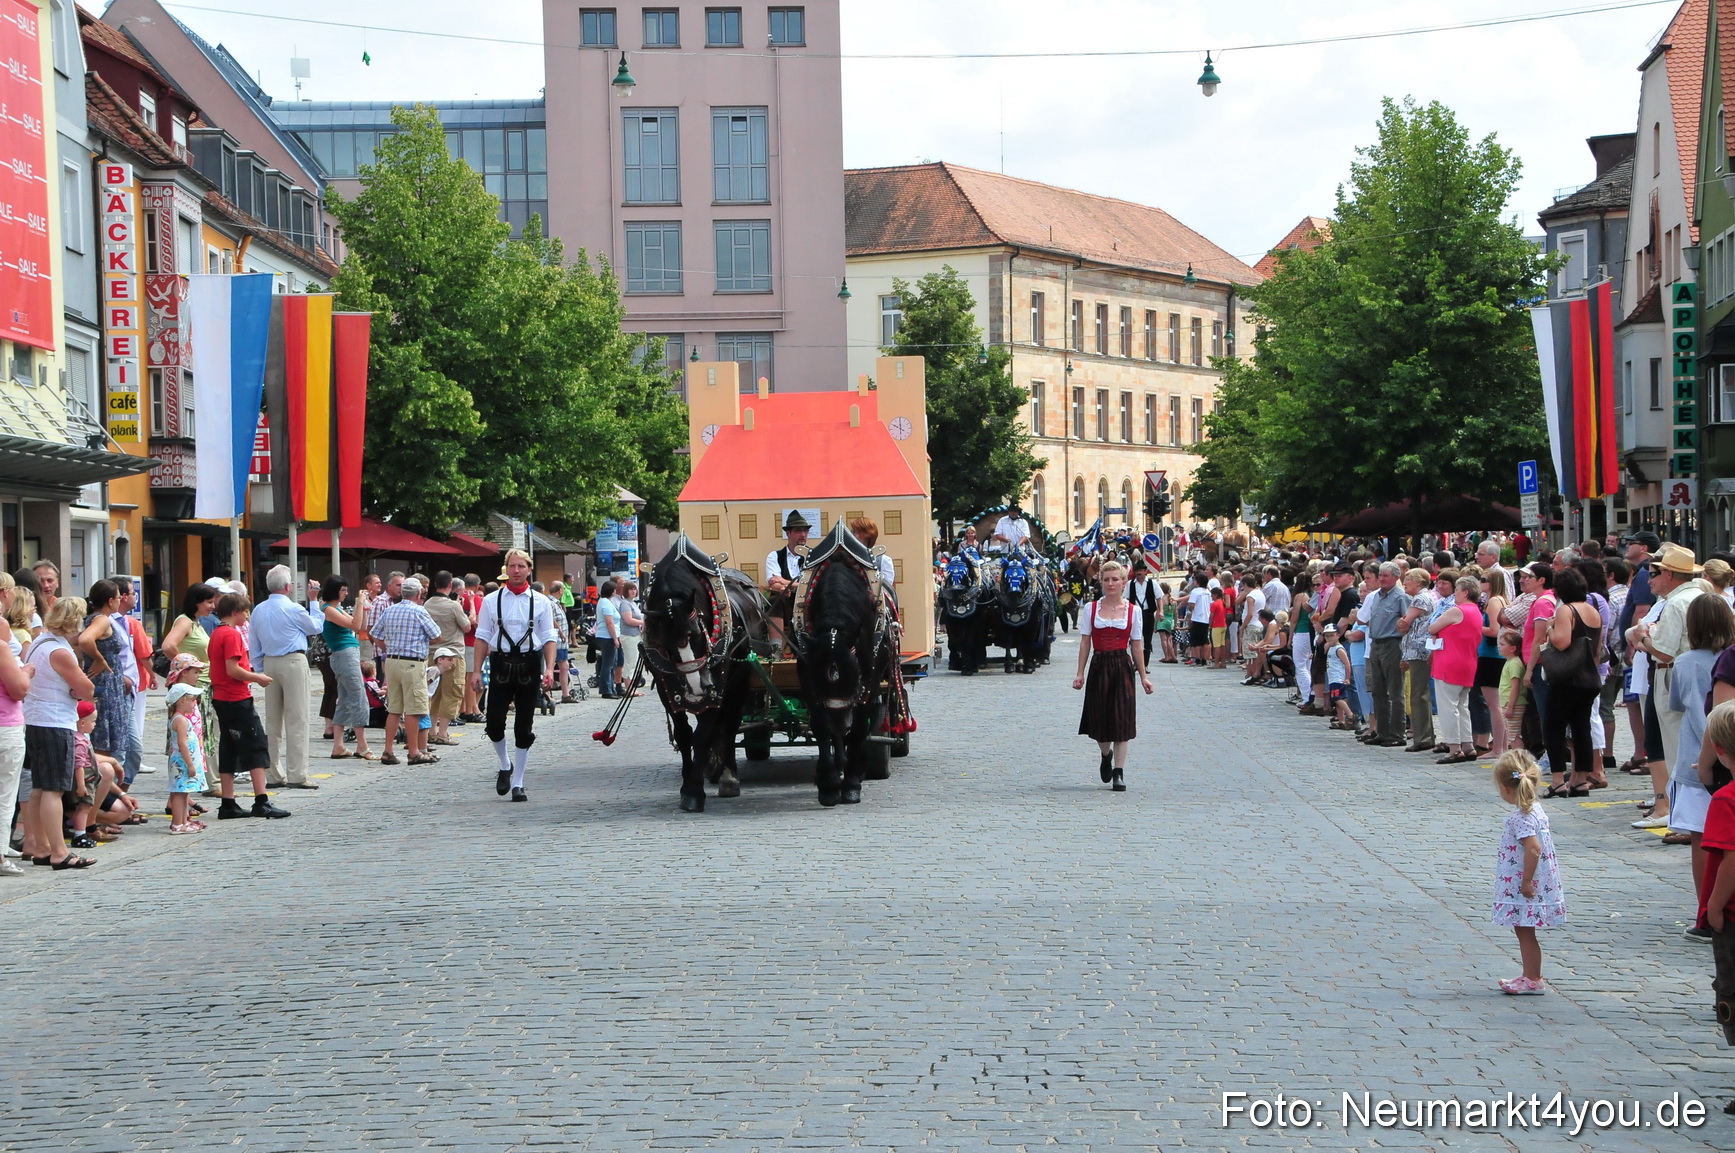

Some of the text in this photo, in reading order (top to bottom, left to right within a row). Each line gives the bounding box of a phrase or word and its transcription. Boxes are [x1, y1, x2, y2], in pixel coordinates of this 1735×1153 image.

[17, 13, 37, 37] SALE
[9, 57, 28, 81] SALE
[23, 113, 42, 135] SALE
[12, 158, 33, 180] SALE
[27, 212, 47, 233] SALE
[18, 257, 38, 278] SALE
[106, 166, 130, 384] BÄCKEREI
[1676, 285, 1693, 471] APOTHEKE
[110, 394, 137, 410] café
[110, 422, 138, 438] plank
[1522, 465, 1533, 490] P
